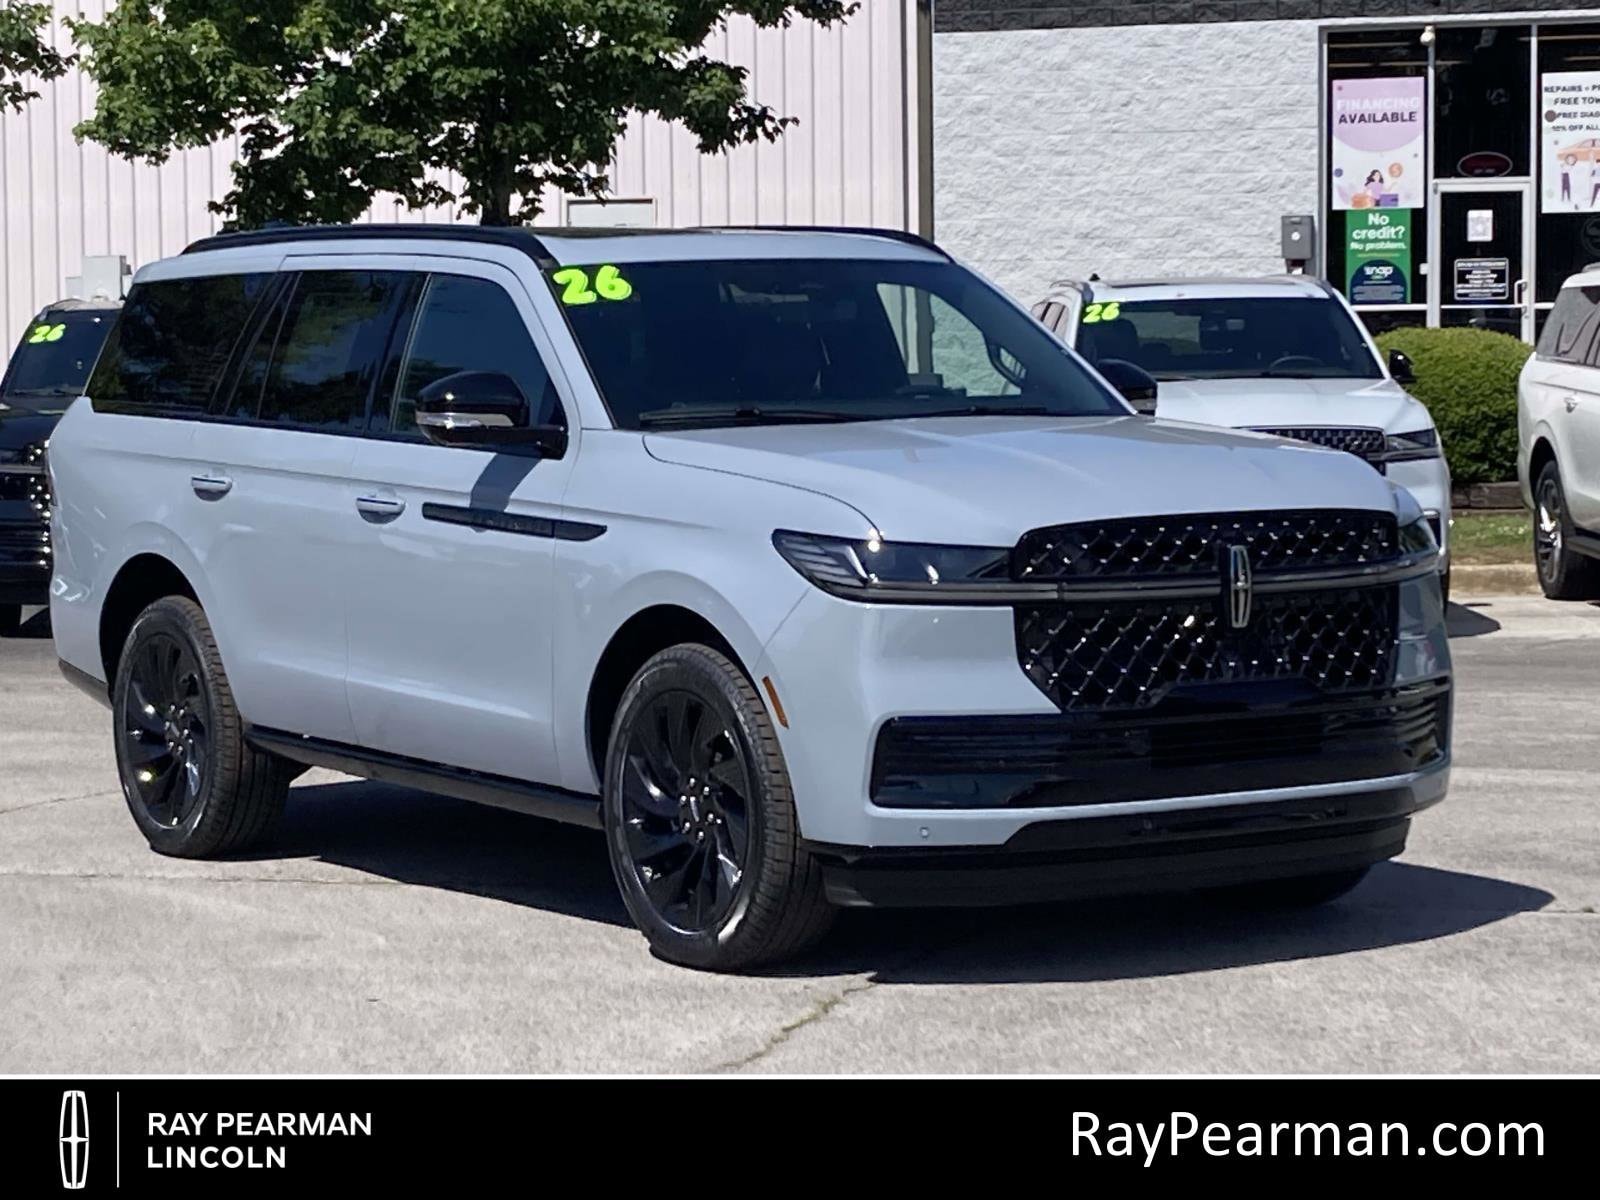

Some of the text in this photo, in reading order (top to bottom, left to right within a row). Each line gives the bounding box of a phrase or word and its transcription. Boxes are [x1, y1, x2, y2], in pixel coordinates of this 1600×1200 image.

[1544, 85, 1582, 93] REPAIRS
[1336, 97, 1419, 111] FINANCING
[1553, 97, 1579, 105] FREE
[1338, 111, 1417, 124] AVAILABLE
[1368, 212, 1390, 226] No
[1352, 225, 1406, 240] credit?
[552, 265, 633, 305] 26
[1082, 302, 1120, 324] 26
[28, 323, 66, 344] 26
